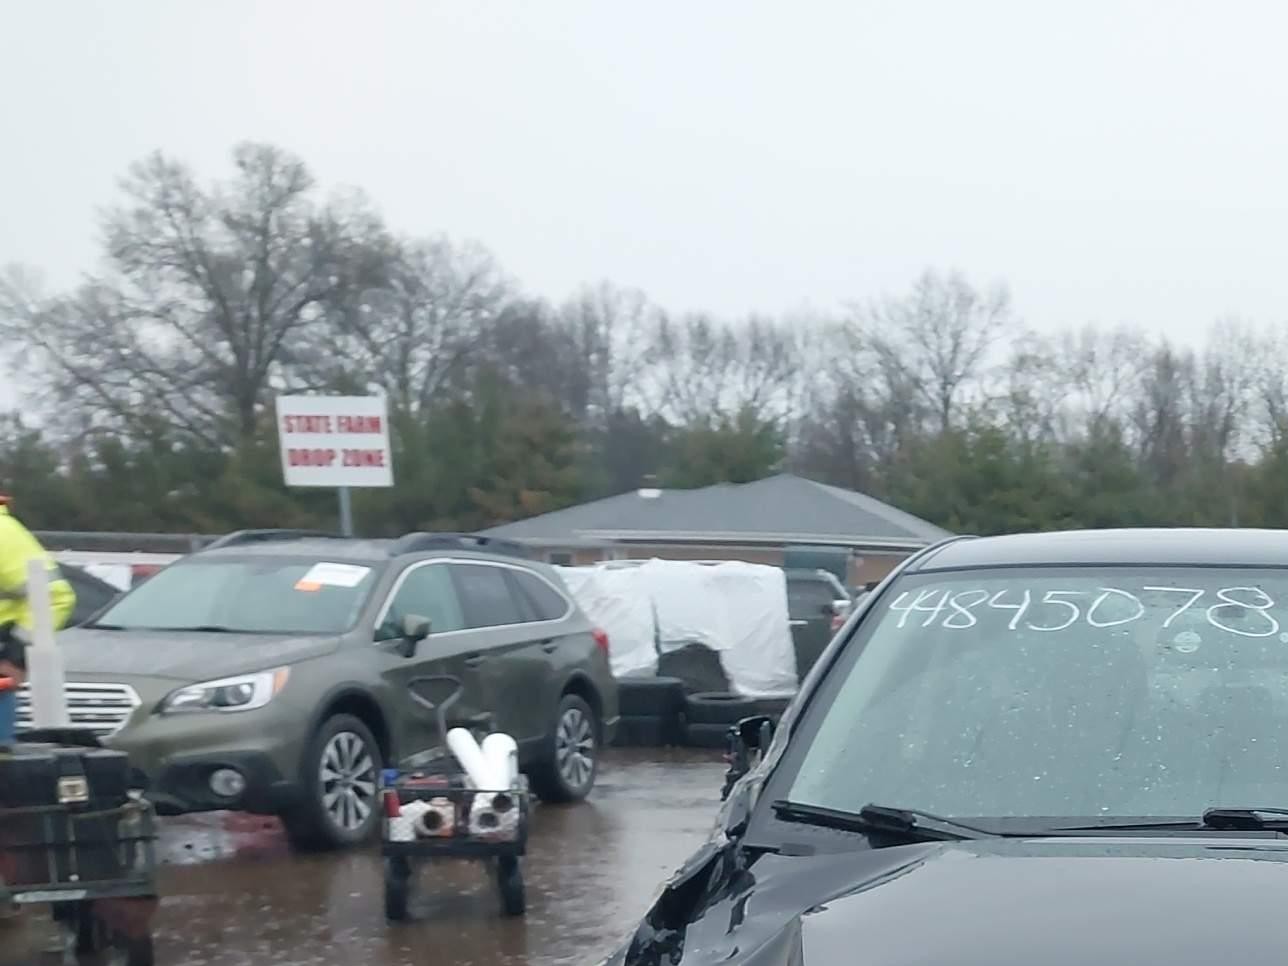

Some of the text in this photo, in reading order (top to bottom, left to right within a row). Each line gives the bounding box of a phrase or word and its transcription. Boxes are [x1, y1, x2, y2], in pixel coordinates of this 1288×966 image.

[284, 415, 383, 433] STATE FARM
[287, 448, 336, 467] DROP
[888, 586, 1280, 637] 44845078
